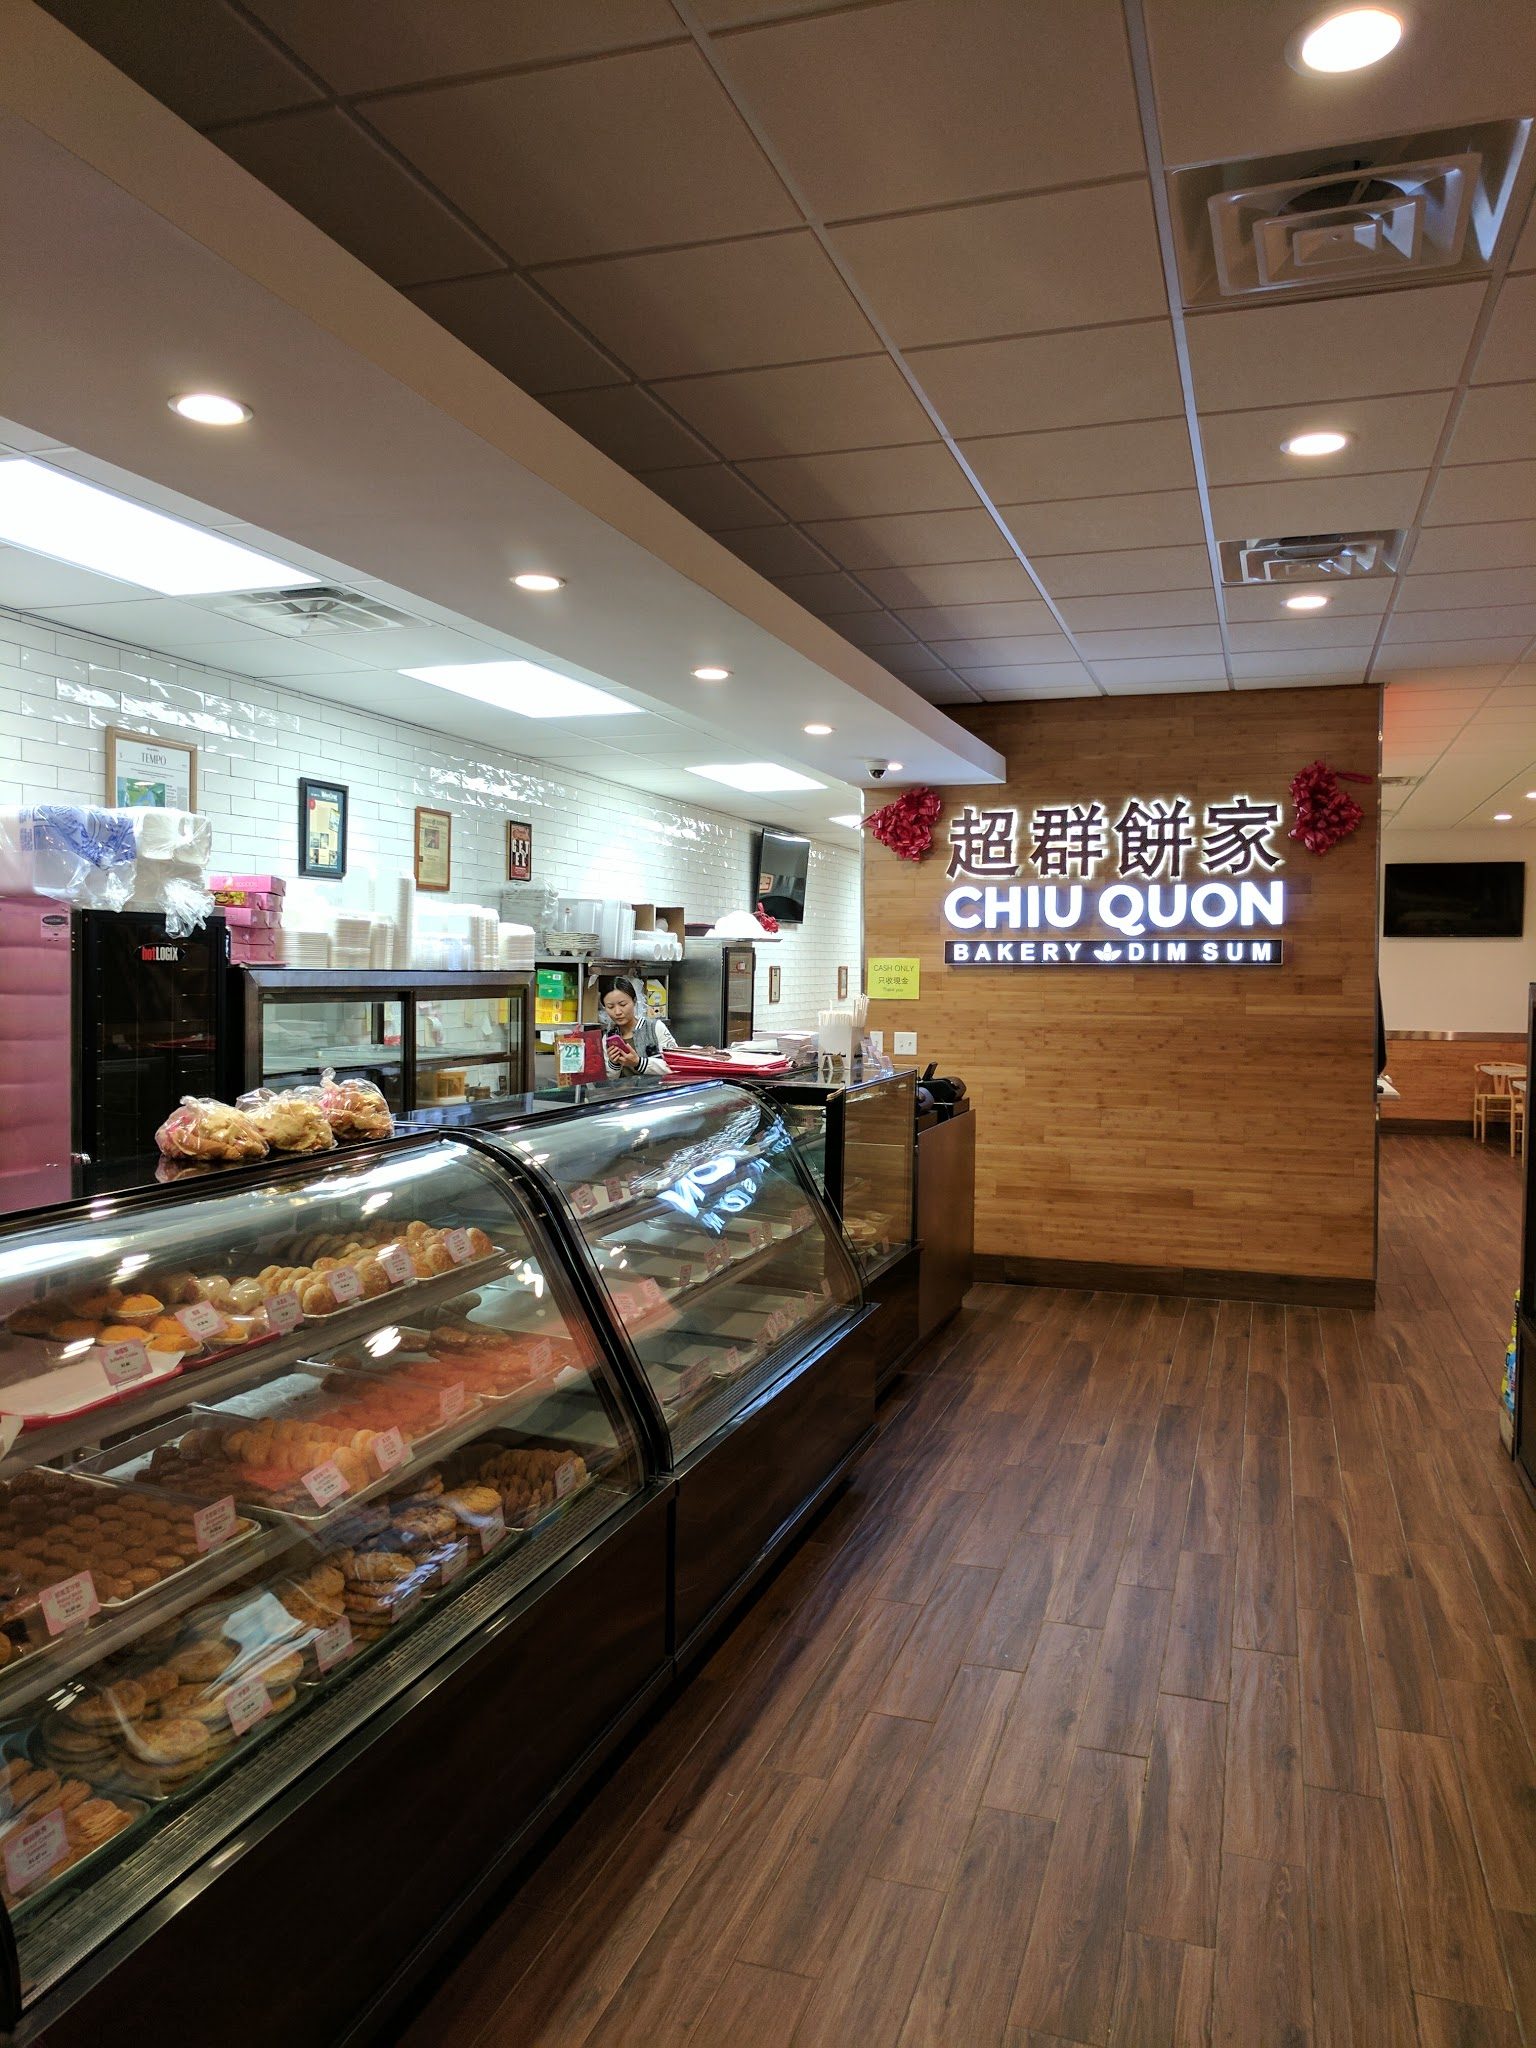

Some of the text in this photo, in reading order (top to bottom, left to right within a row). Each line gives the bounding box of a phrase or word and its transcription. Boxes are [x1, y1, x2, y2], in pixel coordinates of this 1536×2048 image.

[141, 752, 167, 766] TEMPO
[947, 797, 1281, 878] 超群餅家
[944, 881, 1283, 936] CHIU QUON
[953, 942, 1272, 962] BAKERY DIM SUM
[873, 964, 914, 972] CASH ONLY
[564, 1044, 580, 1058] 24
